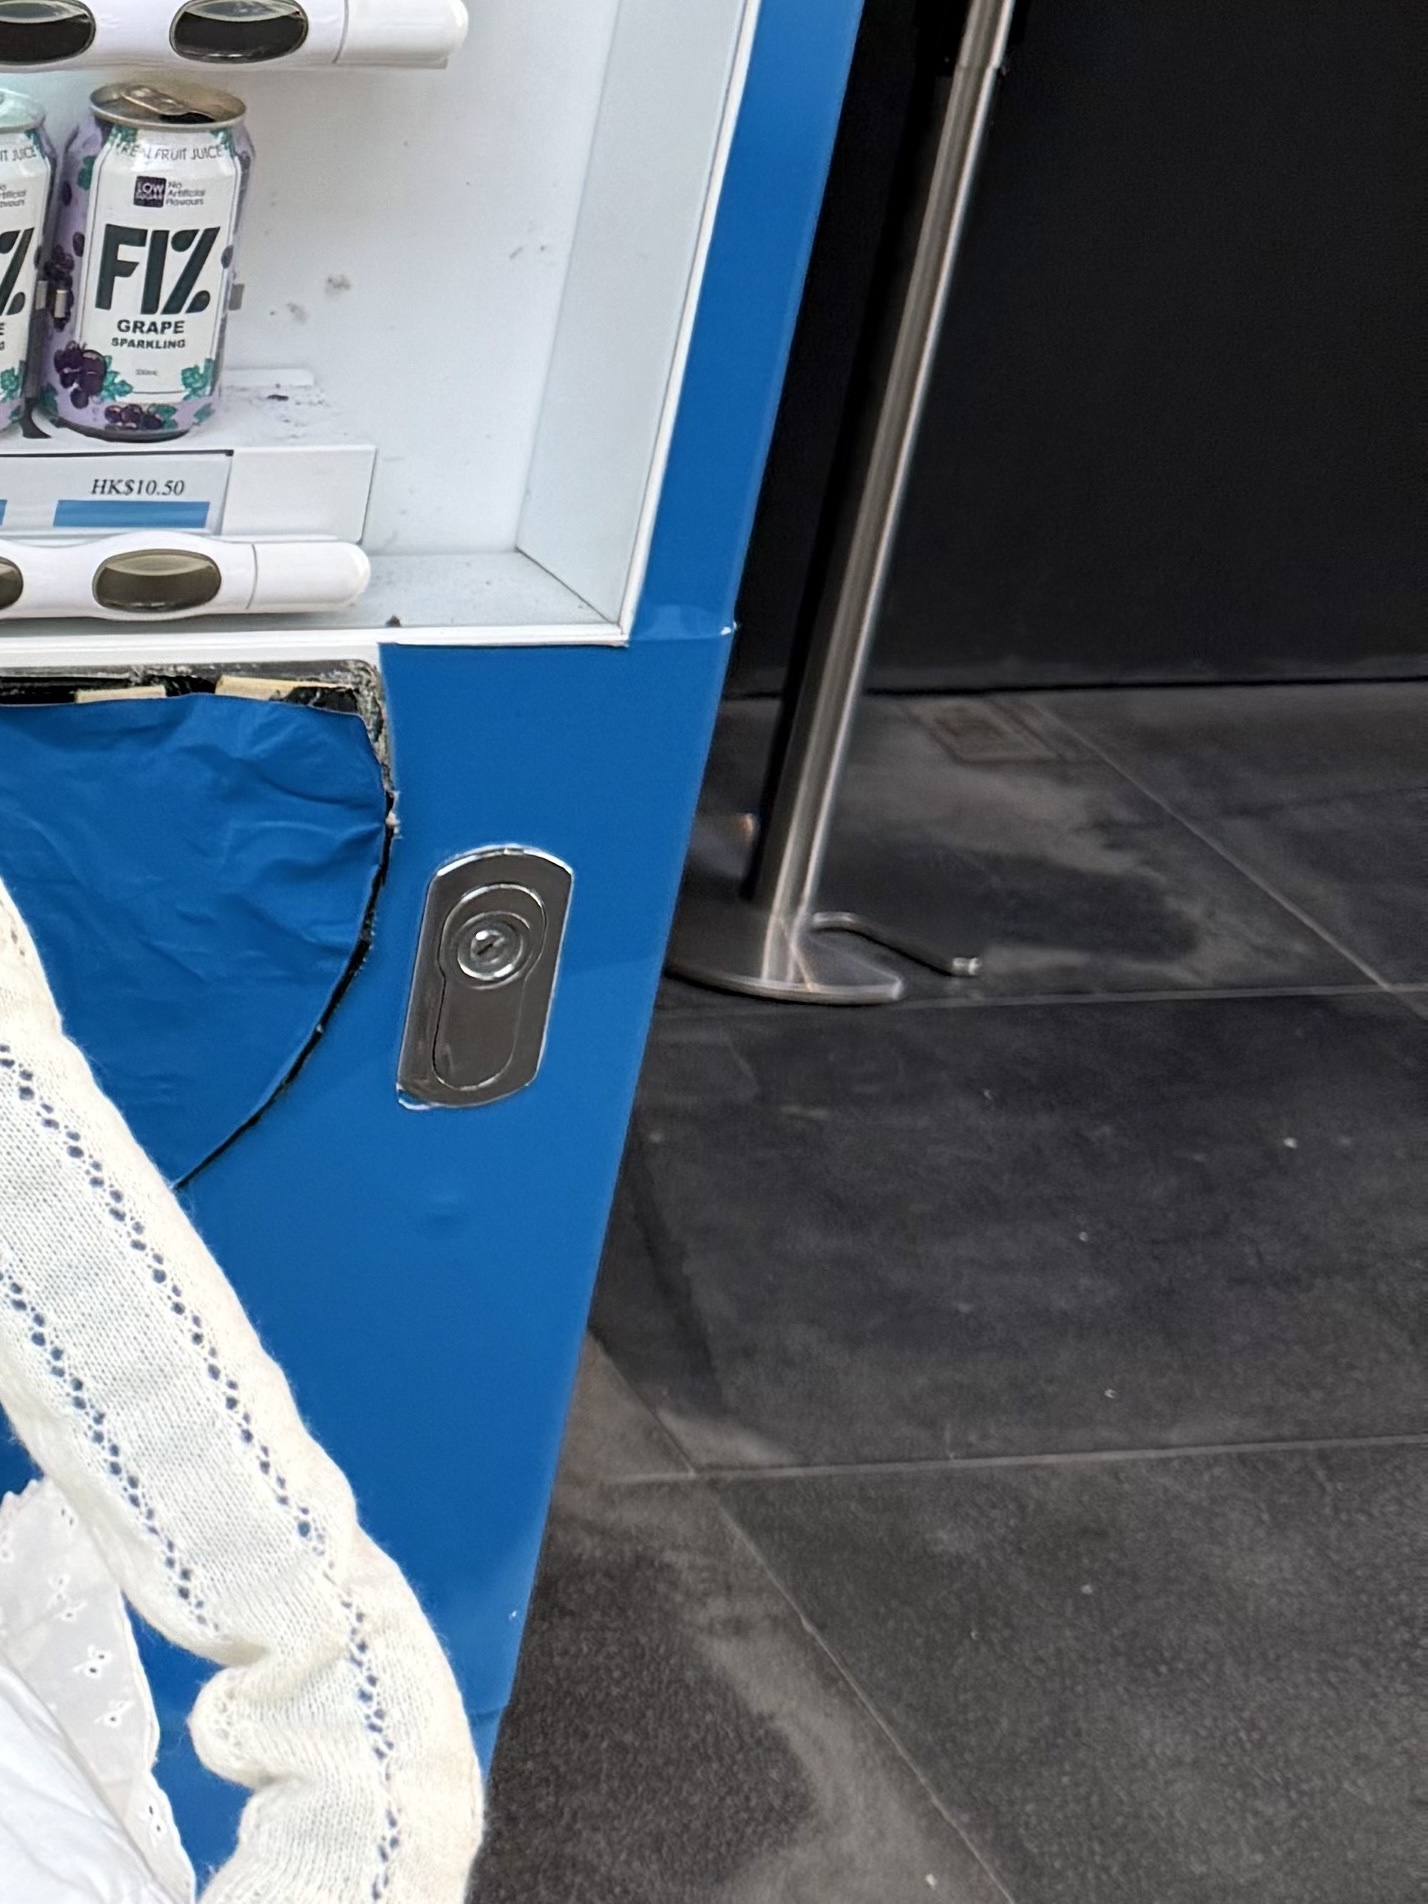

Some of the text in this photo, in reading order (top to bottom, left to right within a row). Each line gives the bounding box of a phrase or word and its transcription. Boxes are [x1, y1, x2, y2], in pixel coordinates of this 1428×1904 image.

[118, 145, 223, 162] REAL FRUIT JUICE
[138, 180, 163, 194] LOW
[94, 224, 222, 315] FIZ
[117, 318, 185, 335] GRAPE
[111, 337, 186, 350] SPARKLING
[91, 479, 185, 495] HK$10.50
